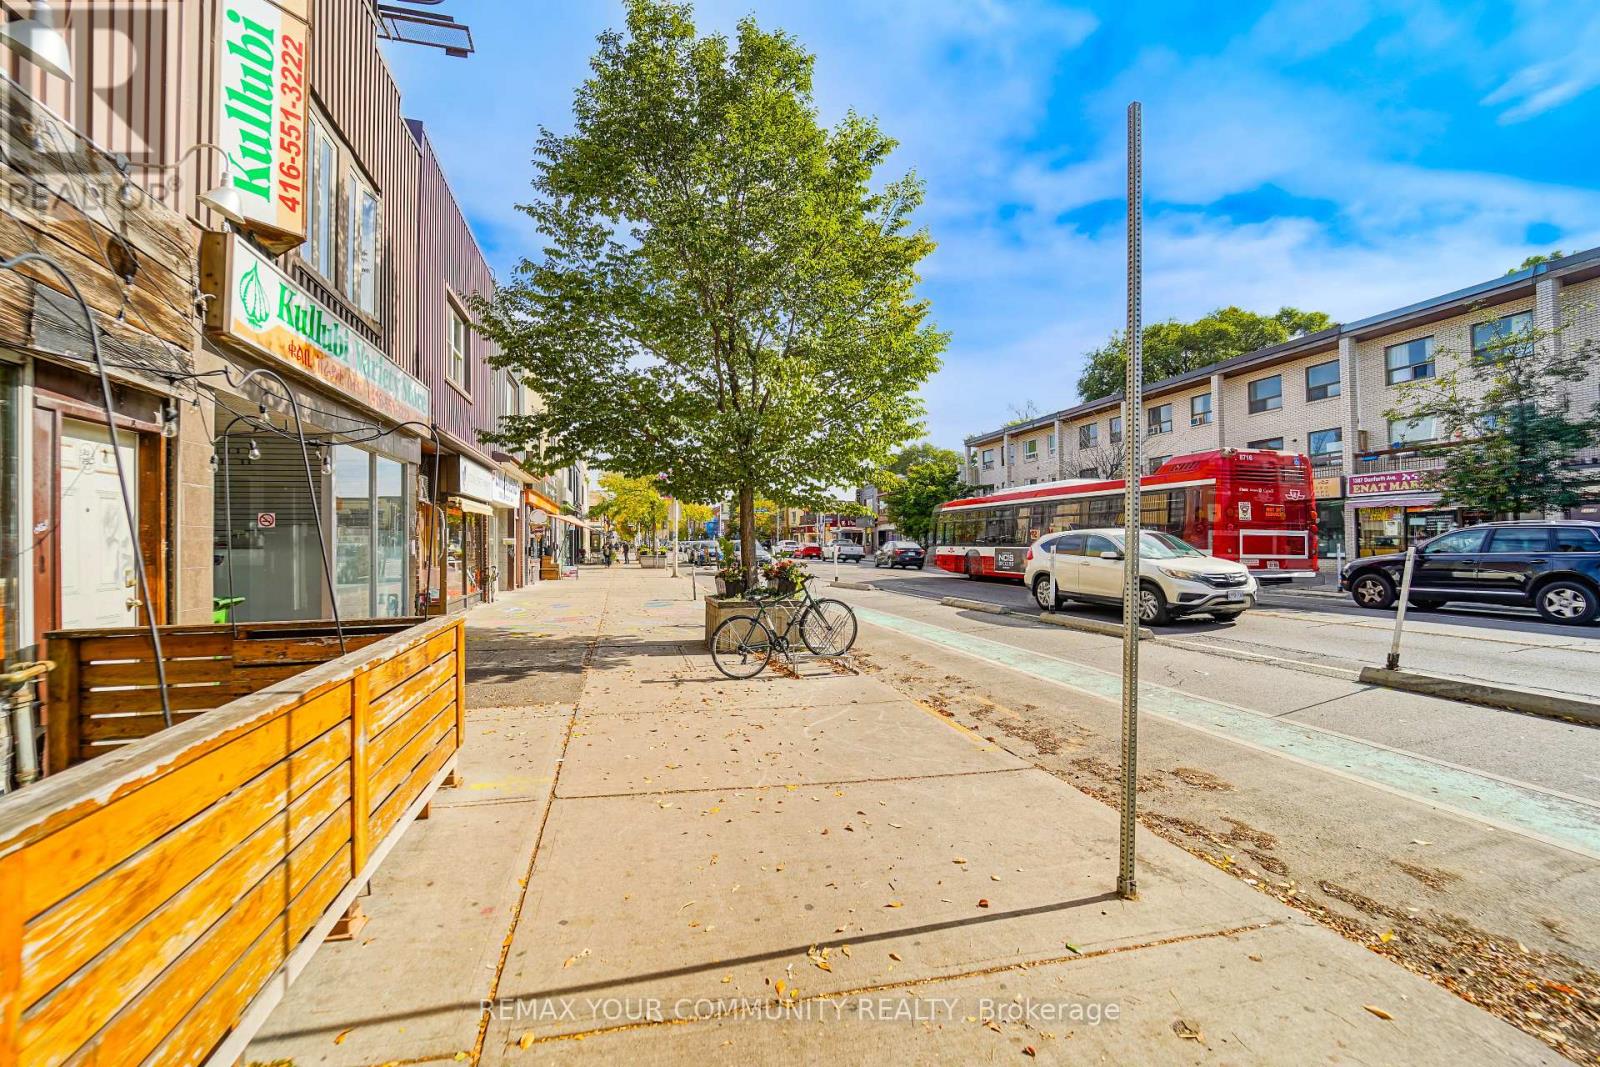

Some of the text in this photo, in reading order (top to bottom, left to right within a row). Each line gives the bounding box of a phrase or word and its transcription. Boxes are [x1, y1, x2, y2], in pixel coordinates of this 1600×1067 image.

[225, 9, 274, 203] Kullubi
[278, 34, 304, 214] 416-551-3222
[277, 282, 349, 360] Kullubi
[1353, 482, 1387, 494] ENAT
[998, 554, 1014, 562] NCIS
